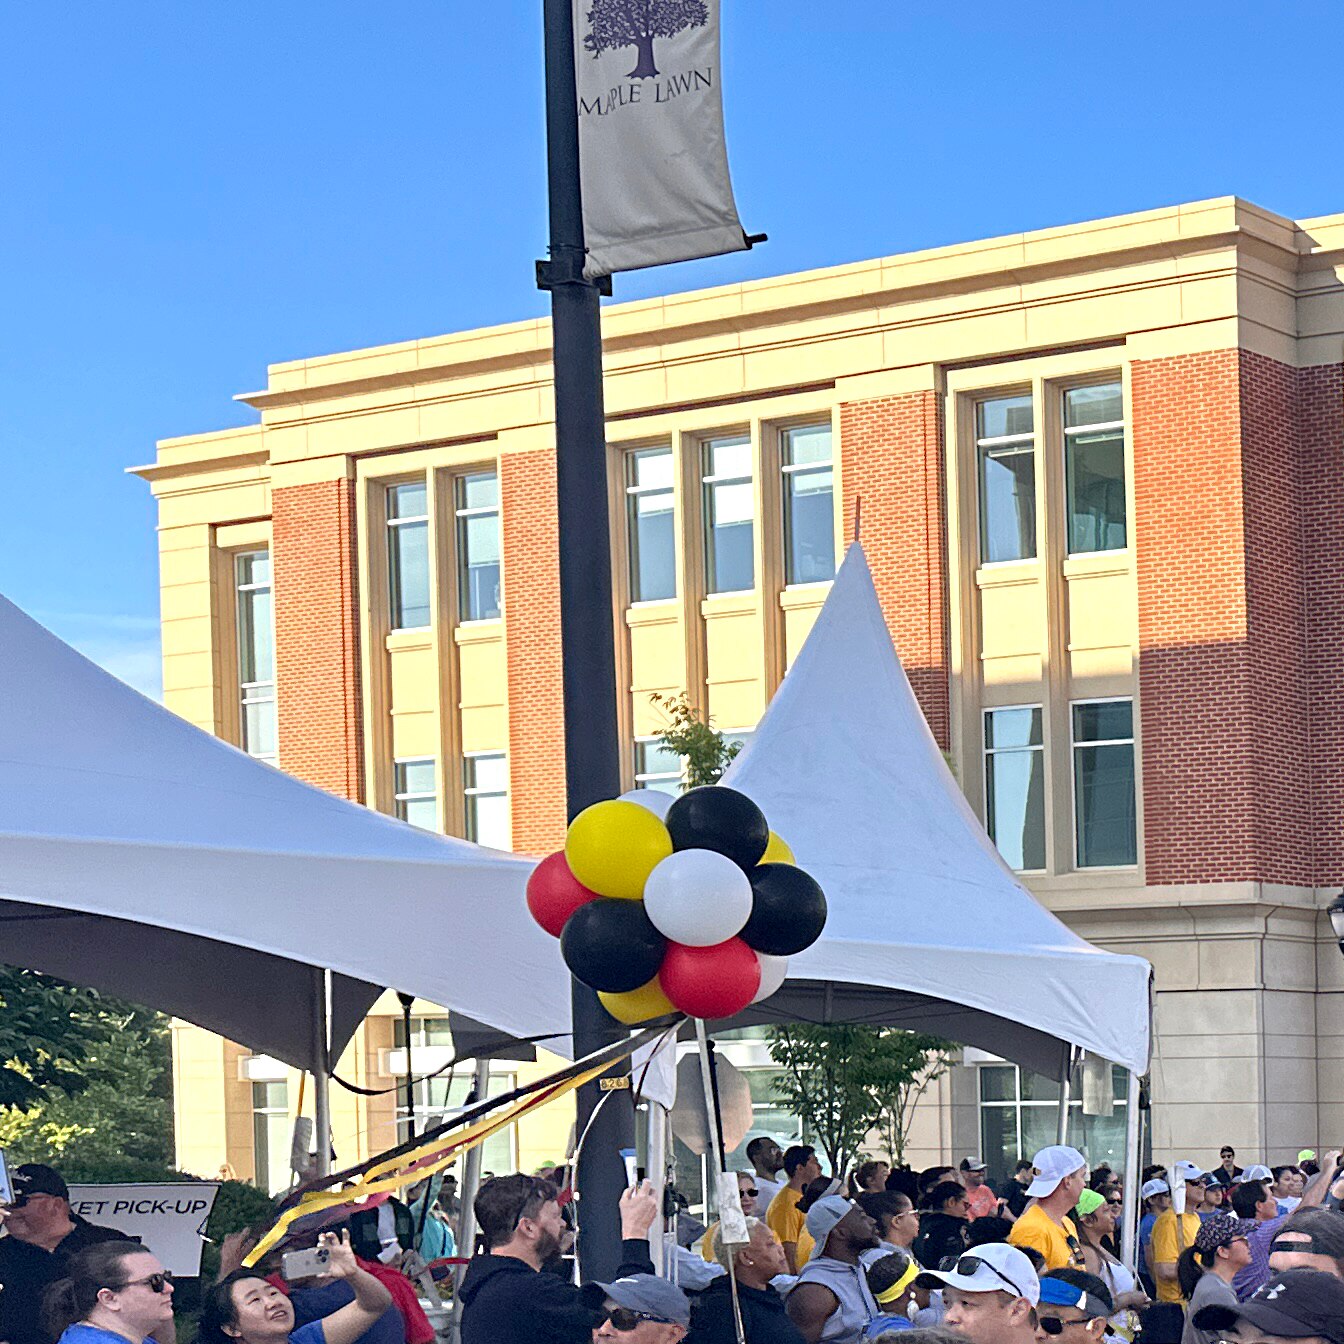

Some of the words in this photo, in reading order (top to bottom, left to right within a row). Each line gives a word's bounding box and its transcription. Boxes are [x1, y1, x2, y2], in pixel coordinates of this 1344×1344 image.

[578, 84, 641, 115] MAPLE
[655, 67, 712, 103] LAWN
[113, 1200, 207, 1214] PICK-UP
